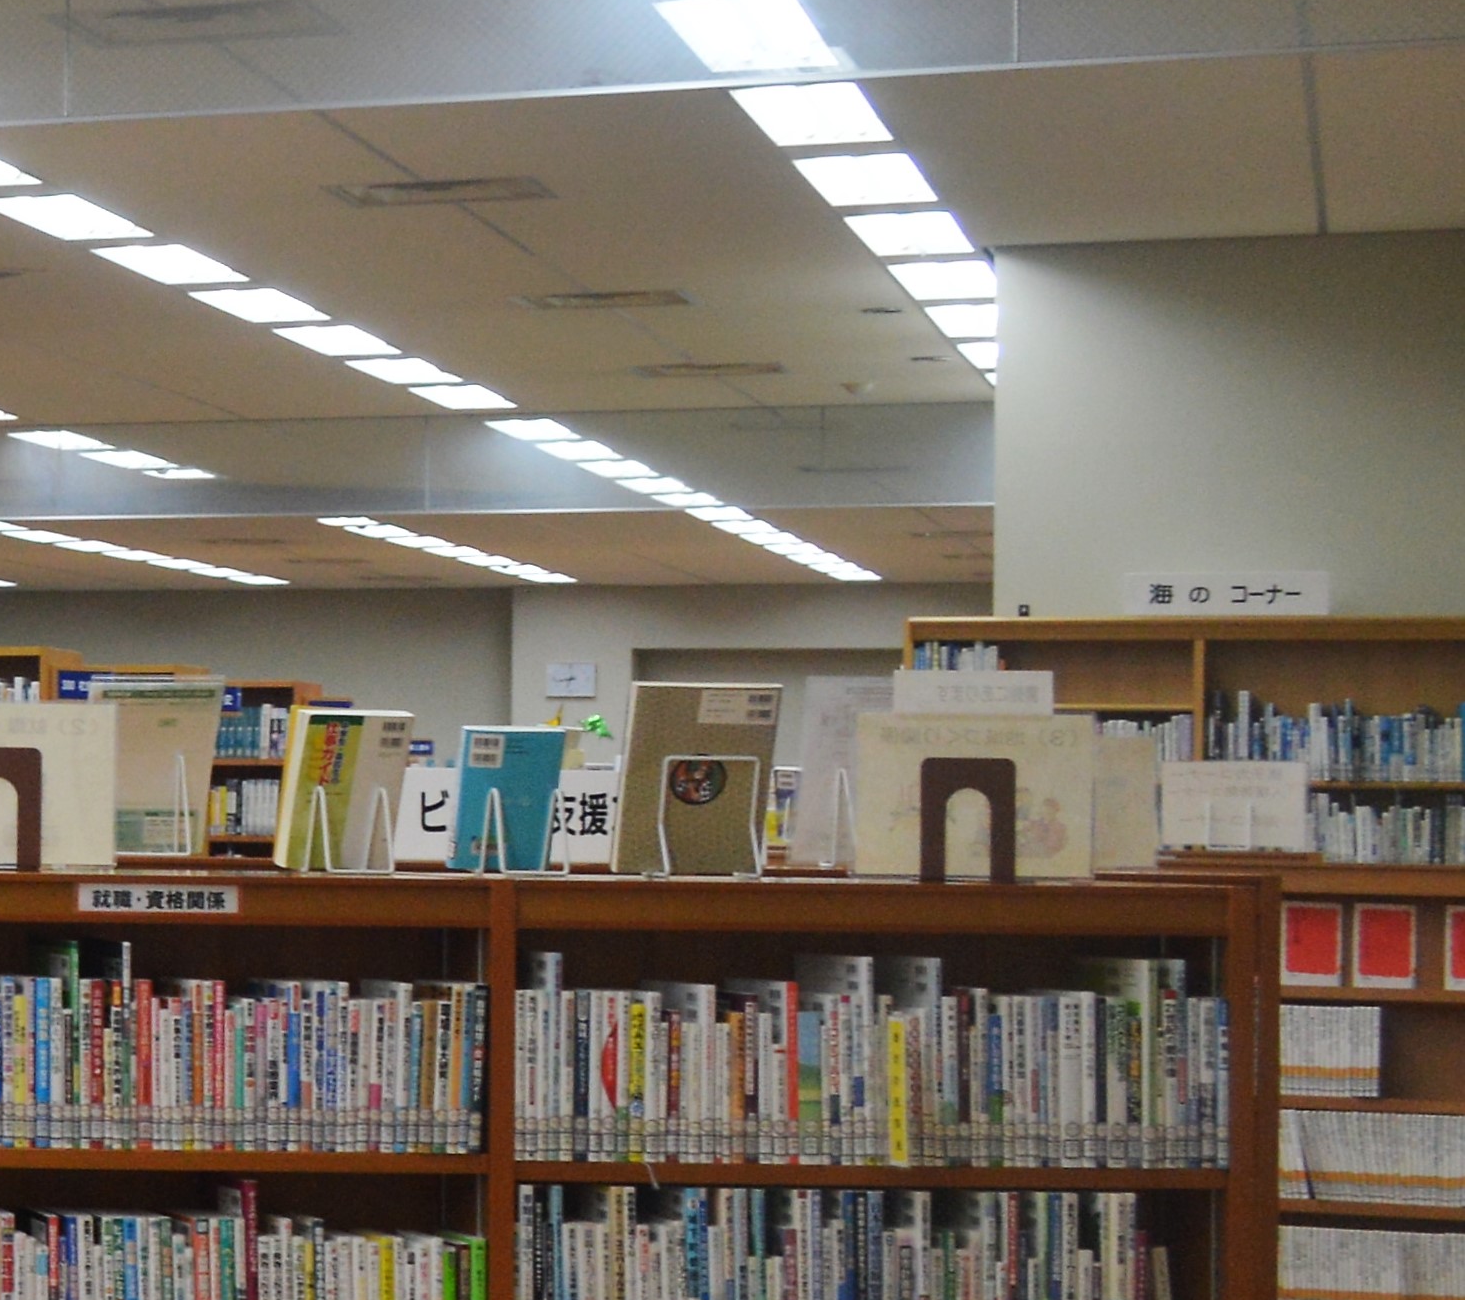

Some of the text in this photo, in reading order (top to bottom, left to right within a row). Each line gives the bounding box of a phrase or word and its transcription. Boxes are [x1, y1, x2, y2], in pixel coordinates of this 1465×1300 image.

[92, 889, 226, 911] 就職・資格関係
